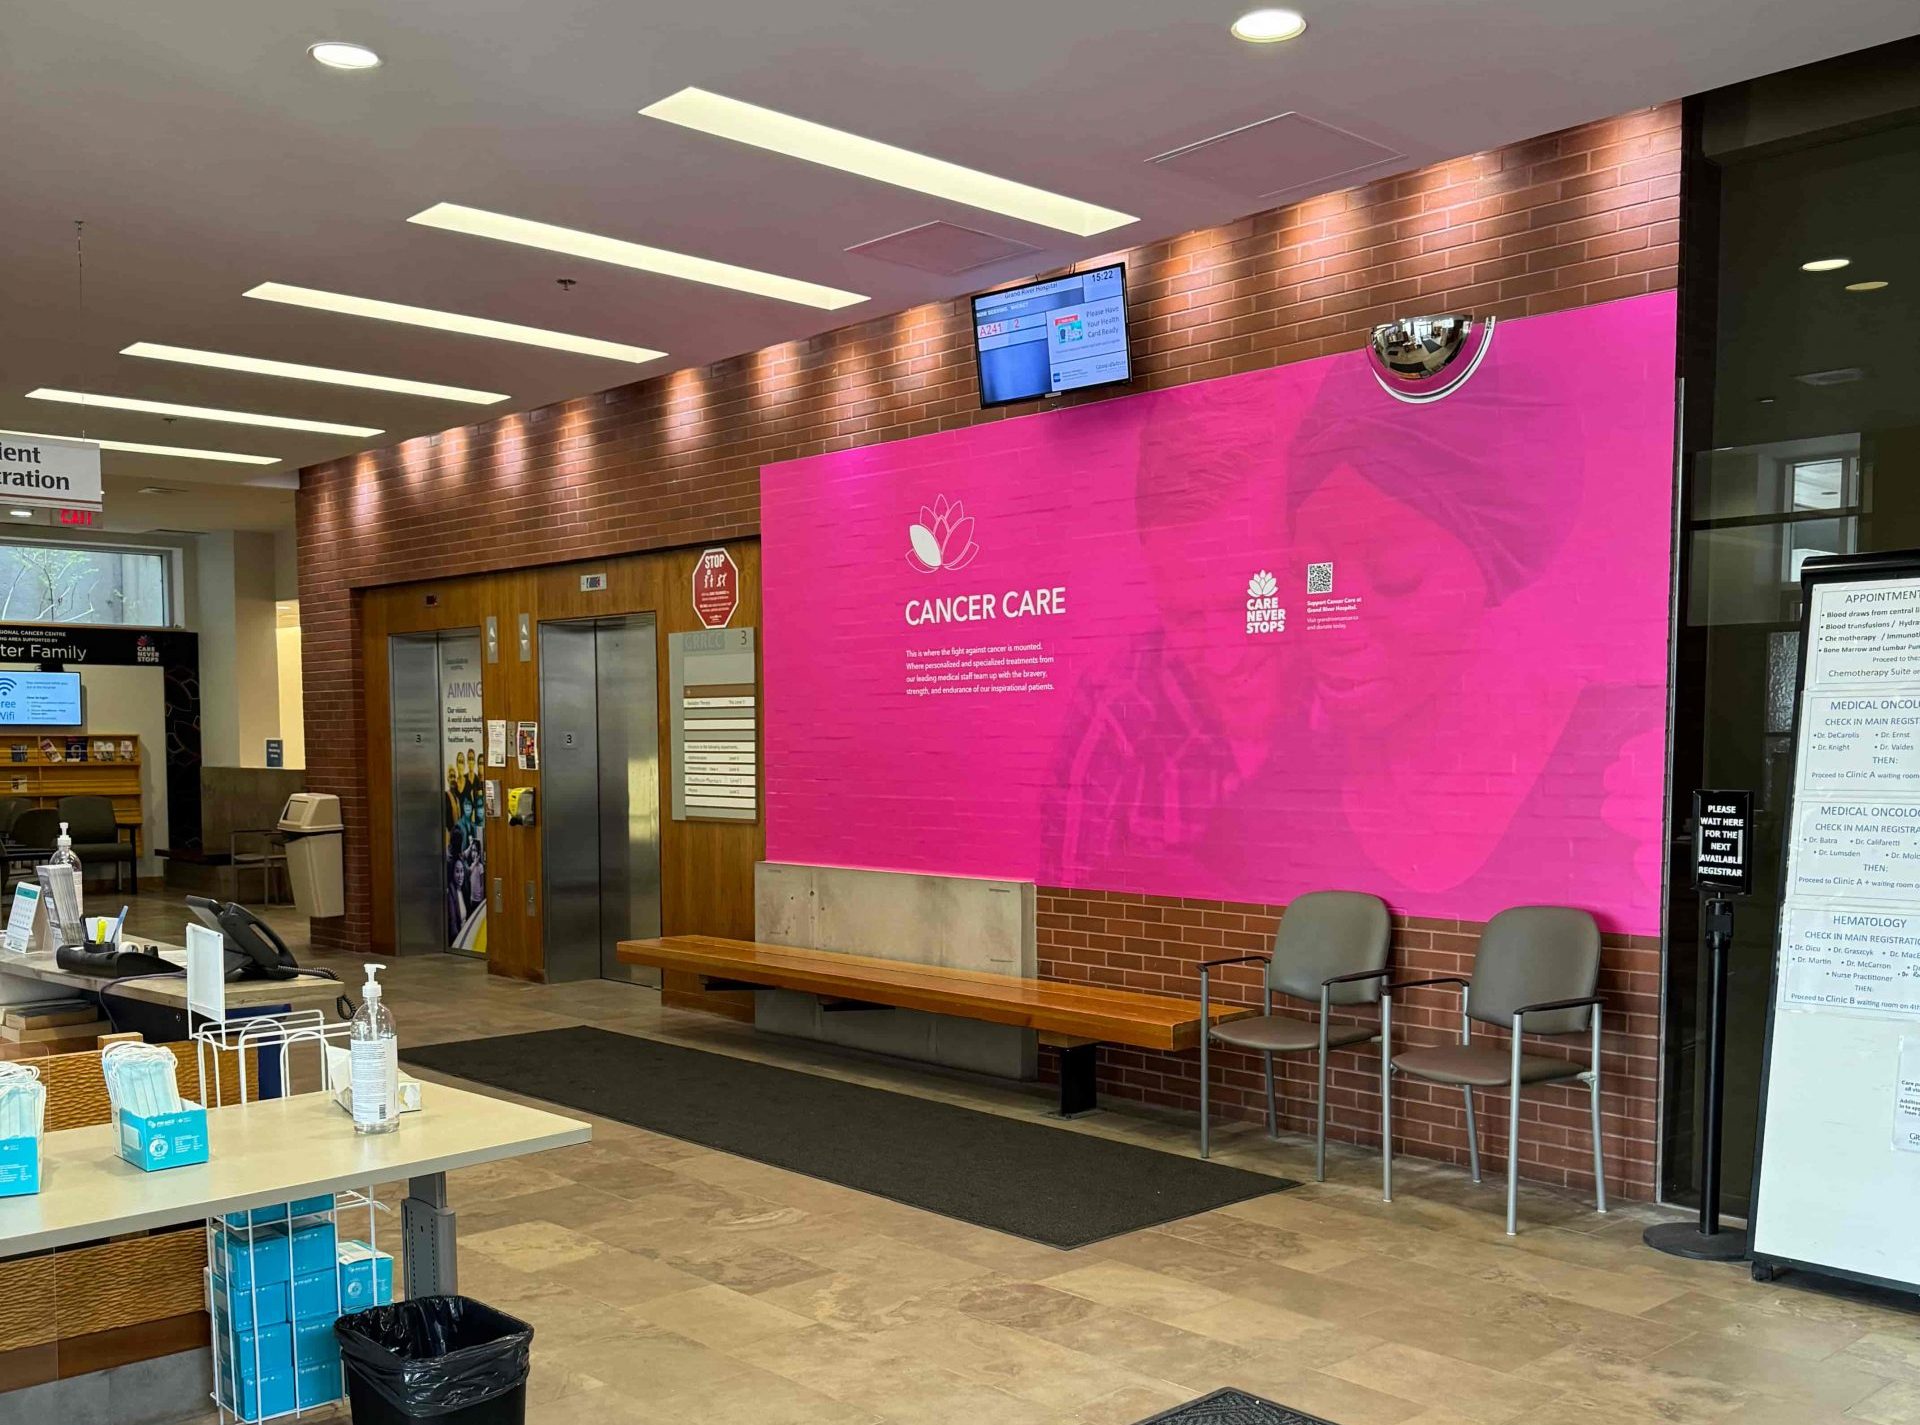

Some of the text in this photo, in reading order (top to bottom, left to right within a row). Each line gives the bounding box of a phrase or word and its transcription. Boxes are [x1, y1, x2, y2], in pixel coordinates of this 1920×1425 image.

[1092, 270, 1113, 282] 15:22
[1005, 289, 1021, 298] Grand
[1036, 283, 1058, 294] Hospital
[1086, 309, 1103, 317] Please
[1102, 316, 1120, 325] Health
[980, 319, 1020, 336] A241 2
[1102, 327, 1118, 336] Ready
[0, 470, 69, 490] ration
[705, 555, 725, 569] STOP
[905, 587, 1066, 626] CANCER CARE
[1247, 597, 1278, 610] CARE
[1247, 609, 1286, 622] NEVER
[1246, 620, 1285, 634] STOPS
[741, 630, 747, 645] 3
[0, 644, 86, 661] ter Family
[951, 647, 965, 656] fight
[966, 646, 986, 655] against
[925, 660, 960, 670] personalized
[973, 657, 1005, 667] specialized
[1006, 656, 1038, 665] treatments
[916, 674, 936, 684] leading
[938, 673, 960, 681] medical
[961, 672, 973, 680] staff
[989, 673, 996, 682] up
[999, 671, 1011, 679] with
[447, 681, 482, 698] AIMING
[943, 685, 972, 693] endurance
[991, 683, 1027, 694] inspirational
[1028, 683, 1054, 691] patients.
[1830, 700, 1878, 710] MEDICAL
[416, 734, 421, 742] 3
[566, 735, 572, 743] 3
[1708, 805, 1736, 814] PLEASE
[1820, 806, 1868, 816] MEDICAL
[1700, 817, 1744, 826] WAIT HERE
[1722, 830, 1738, 839] THE
[1710, 842, 1732, 851] NEXT
[1699, 854, 1742, 864] AVAILABLE
[1698, 866, 1742, 877] REGISTRAR
[1833, 877, 1854, 885] Clinic
[1833, 915, 1907, 928] HEMATOLOGY
[1805, 931, 1831, 940] CHECK
[1844, 933, 1868, 942] MAIN
[1858, 961, 1891, 970] McCarron
[1853, 973, 1892, 982] Practitioner
[1826, 994, 1848, 1004] Clinic
[1857, 999, 1880, 1008] waiting
